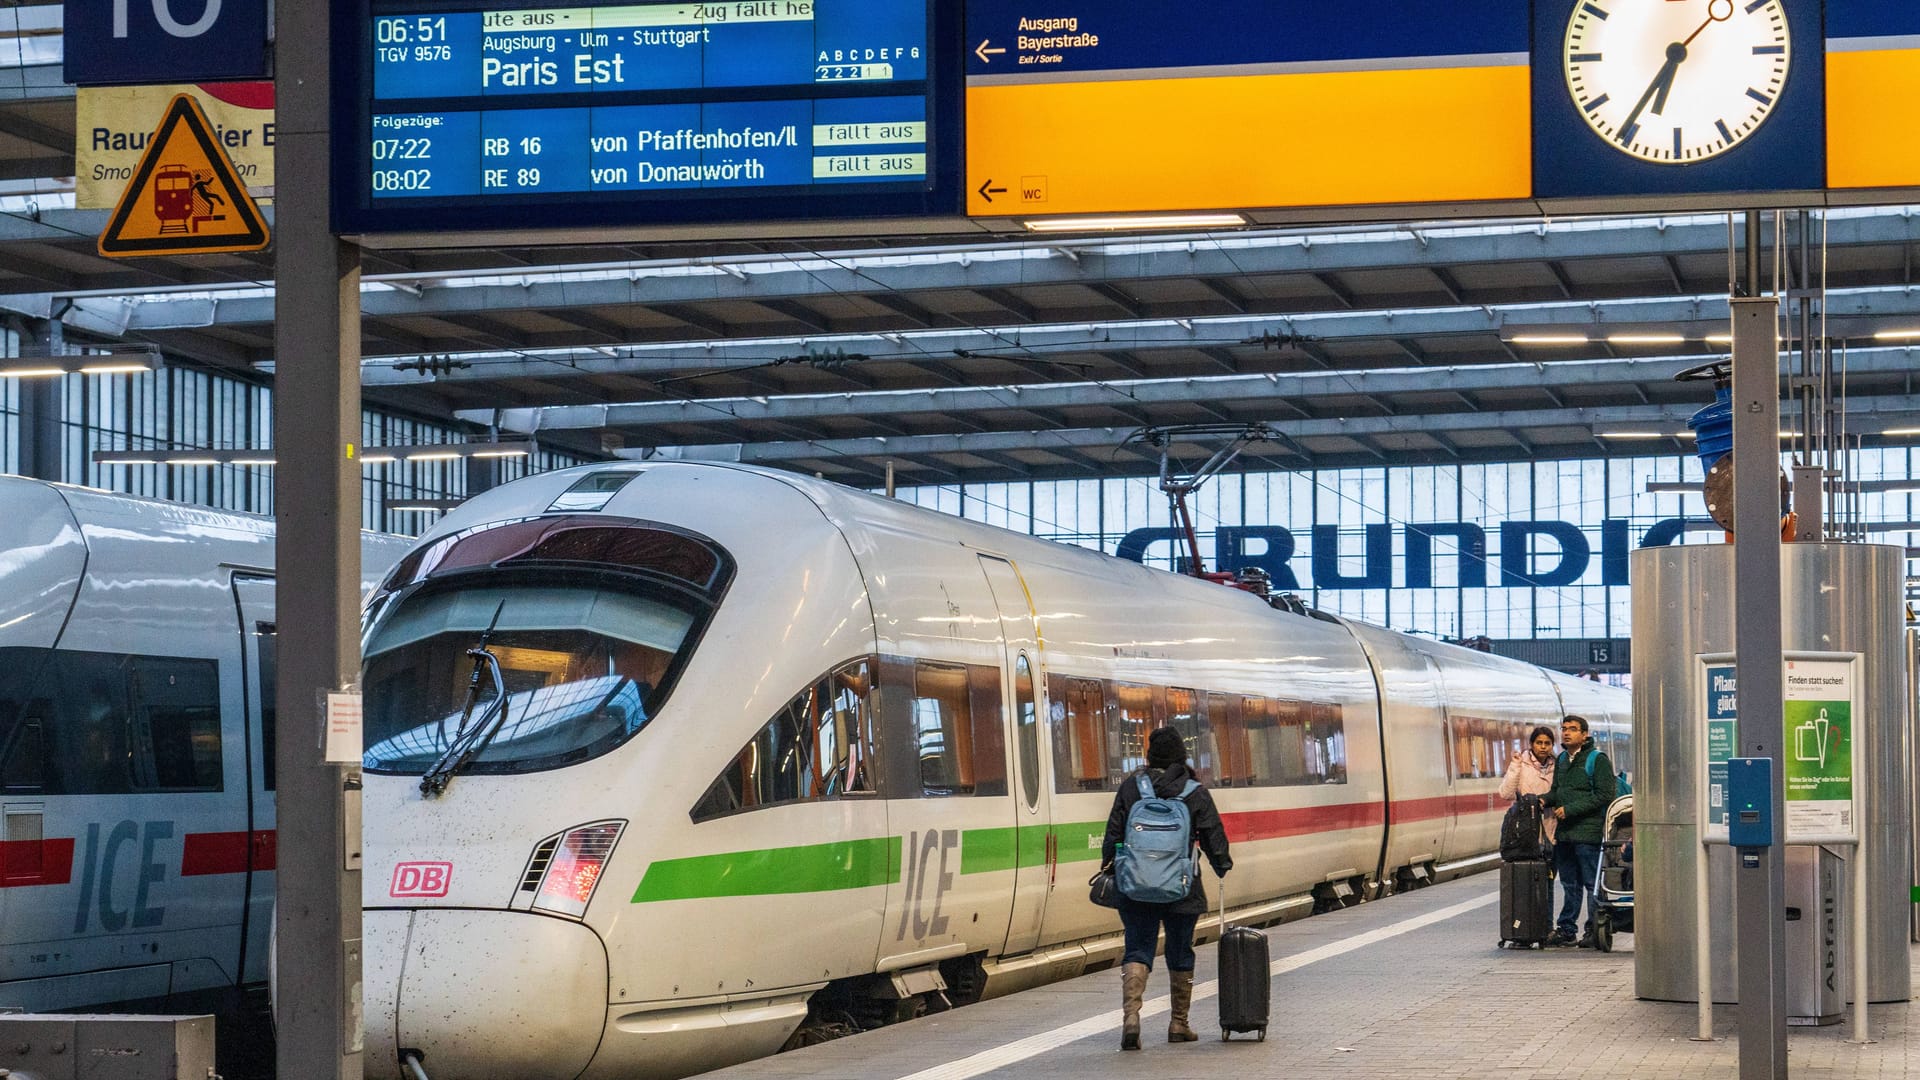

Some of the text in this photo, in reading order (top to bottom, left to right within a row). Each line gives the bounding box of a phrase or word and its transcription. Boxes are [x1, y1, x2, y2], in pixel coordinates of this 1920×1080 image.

[522, 12, 555, 26] aus
[693, 5, 727, 21] Zug
[1018, 17, 1078, 33] Ausgang
[377, 17, 448, 44] 06:51
[483, 35, 556, 54] Augsburg
[580, 32, 609, 47] Ulm
[633, 27, 710, 47] Stuttgart
[1018, 32, 1099, 52] Bayerstraße
[378, 45, 451, 63] TGV 9576
[819, 47, 920, 62] A B C D E F G
[1018, 55, 1033, 64] Exit
[1040, 54, 1063, 64] Sortie
[483, 53, 625, 87] Paris Est
[821, 67, 829, 79] 2
[835, 67, 843, 78] 2
[850, 66, 858, 78] 2
[373, 115, 444, 129] Folgezüge:
[828, 124, 913, 140] fallt aus
[372, 138, 431, 160] 07:22
[484, 137, 510, 156] RB
[519, 137, 542, 155] 16
[591, 136, 627, 153] von
[828, 156, 913, 172] fallt aus
[372, 158, 764, 190] 08:02 RE 89 von Donauwörth
[1023, 189, 1041, 199] WC
[1593, 649, 1609, 663] 15
[1788, 675, 1844, 686] Finden statt suchen!
[74, 819, 174, 934] ICE
[396, 865, 446, 893] DB
[896, 828, 958, 942] ICE
[1824, 898, 1835, 993] Abfall
